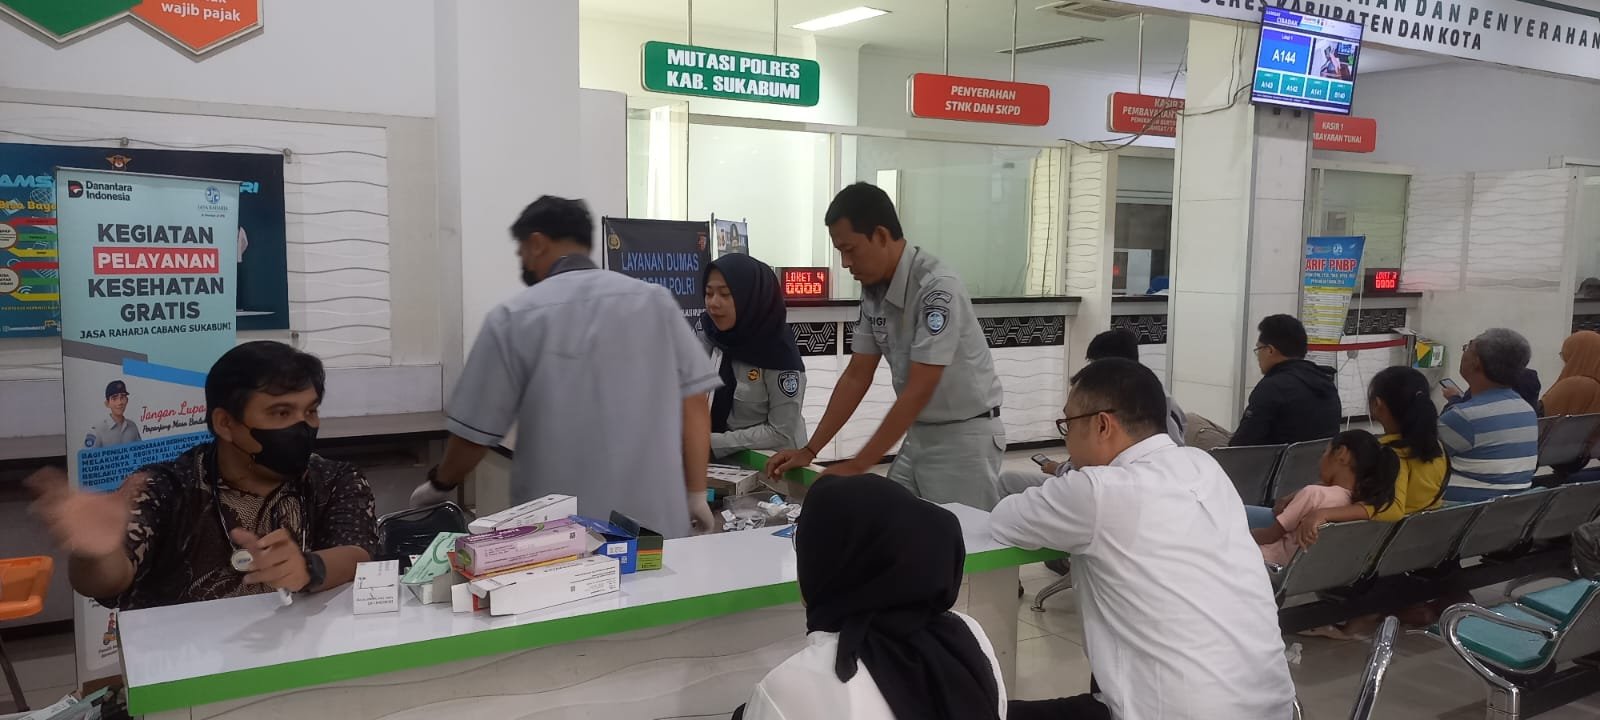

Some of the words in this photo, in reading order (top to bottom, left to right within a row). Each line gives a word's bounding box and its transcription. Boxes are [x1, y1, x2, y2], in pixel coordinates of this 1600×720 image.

[161, 2, 200, 18] wajib
[203, 8, 241, 22] pajak
[1397, 19, 1434, 42] DAN
[1437, 26, 1482, 50] KOTA
[667, 48, 735, 72] MUTASI
[739, 57, 800, 79] POLRES
[1271, 49, 1297, 65] A144
[666, 70, 708, 90] KAB.
[712, 75, 800, 99] SUKABUMI
[951, 85, 1017, 101] PENYERAHAN
[945, 100, 973, 112] STNK
[973, 103, 994, 114] DAN
[995, 104, 1021, 116] SKPD
[1154, 98, 1178, 109] KASIR
[1322, 121, 1340, 130] KASIR
[1343, 135, 1362, 144] TUNAI
[86, 180, 133, 192] Danantara
[86, 190, 131, 201] Indonesia
[97, 223, 214, 245] KEGIATAN
[97, 252, 216, 270] PELAYANAN
[621, 252, 664, 272] LAYANAN
[666, 252, 700, 272] DUMAS
[1328, 258, 1358, 272] PNBP
[785, 271, 813, 283] LOKET
[816, 271, 825, 282] 4
[88, 277, 225, 298] KESEHATAN
[669, 277, 696, 295] POLRI
[120, 301, 201, 322] GRATIS
[79, 329, 106, 339] JASA
[108, 327, 149, 338] RAHARJA
[150, 324, 187, 335] CABANG
[188, 321, 232, 332] SUKABUMI
[140, 406, 177, 422] Jangan
[82, 454, 130, 466] MELAKUKAN
[133, 447, 171, 459] REGISTRASI
[82, 461, 130, 473] KURANGNYA
